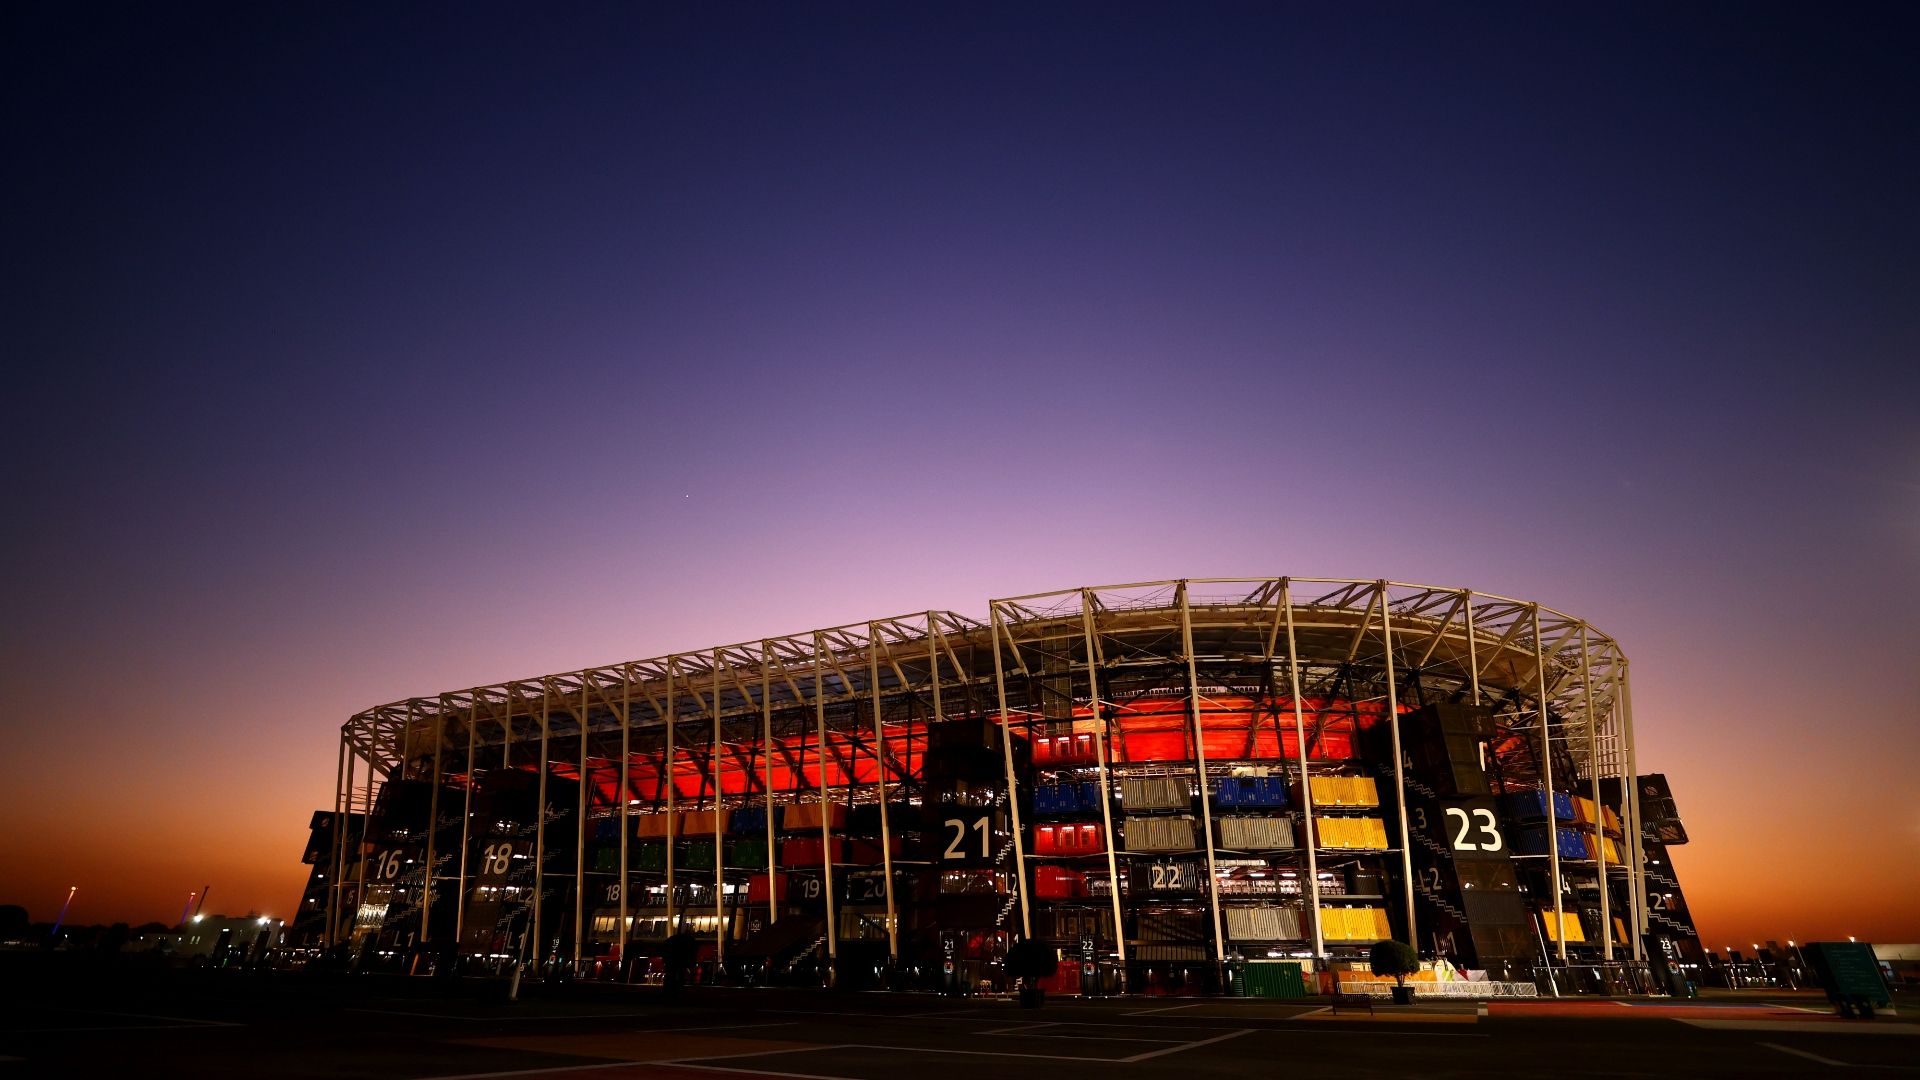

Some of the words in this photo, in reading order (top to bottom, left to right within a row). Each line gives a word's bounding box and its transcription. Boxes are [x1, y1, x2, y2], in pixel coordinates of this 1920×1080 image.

[943, 815, 990, 860] 21
[1445, 807, 1503, 852] 23
[376, 849, 403, 880] 16
[484, 842, 513, 875] 18
[1151, 865, 1182, 889] 22
[1417, 867, 1443, 893] L2
[606, 884, 621, 902] 18
[802, 879, 820, 899] 19
[864, 879, 886, 898] 20
[392, 930, 415, 948] L1
[944, 940, 954, 950] 21
[1082, 940, 1094, 950] 22
[1431, 931, 1458, 956] L1
[1660, 939, 1672, 950] 23
